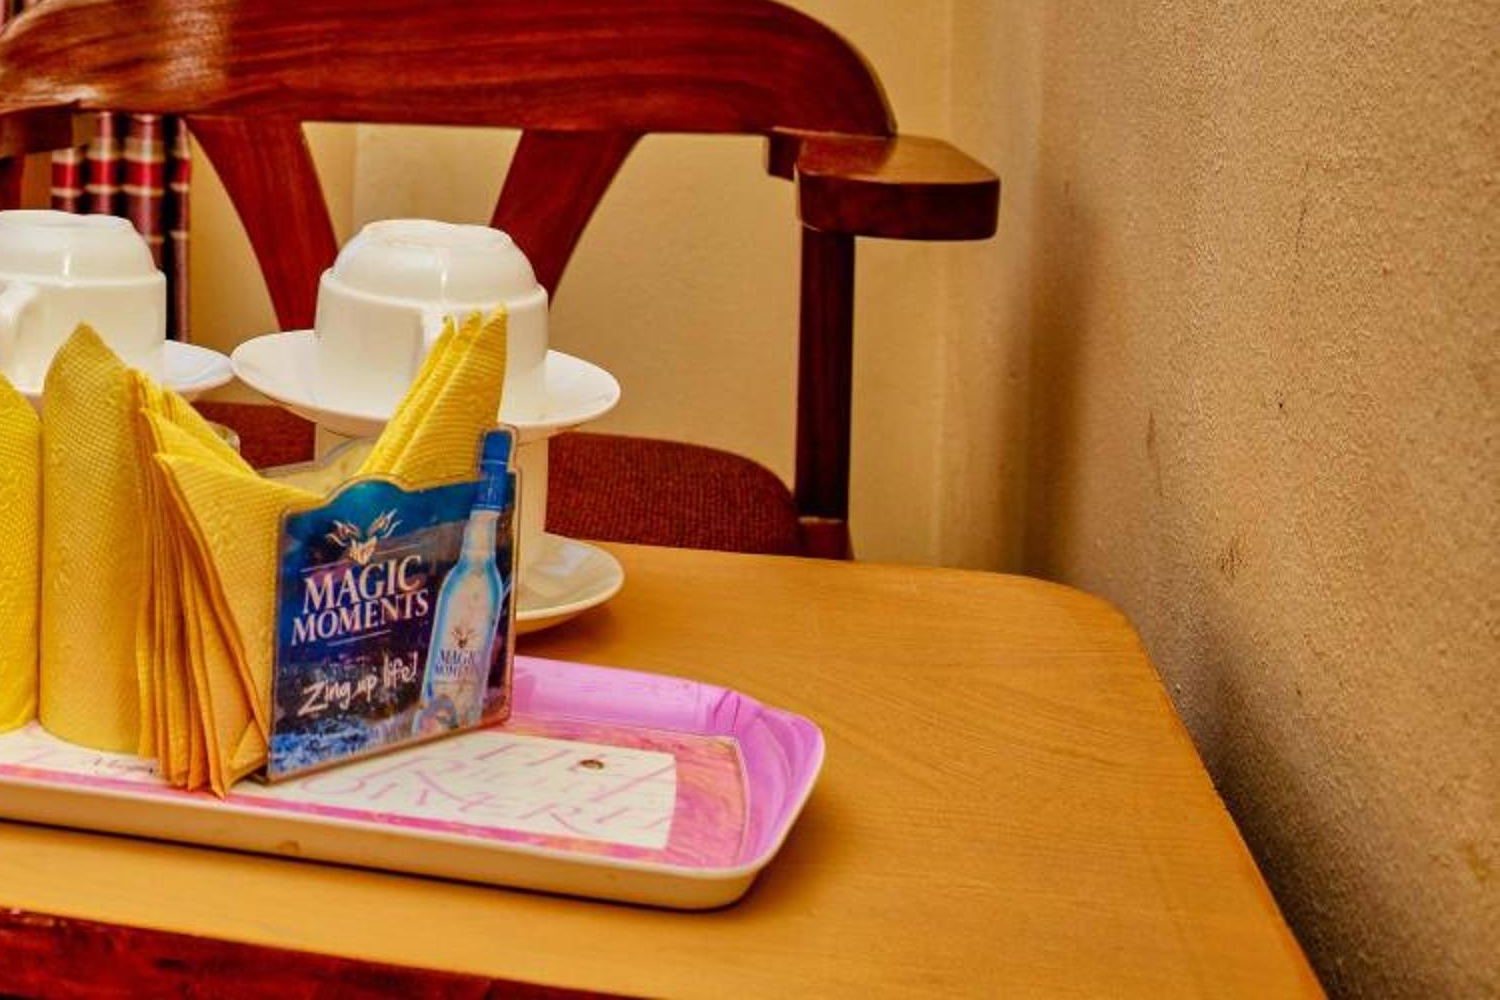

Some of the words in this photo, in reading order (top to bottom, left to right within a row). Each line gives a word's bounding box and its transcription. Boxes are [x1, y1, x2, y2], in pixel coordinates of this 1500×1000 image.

[303, 555, 421, 614] MAGIC
[291, 589, 429, 646] MOMENTS
[297, 679, 351, 716] Zing
[354, 674, 379, 702] up
